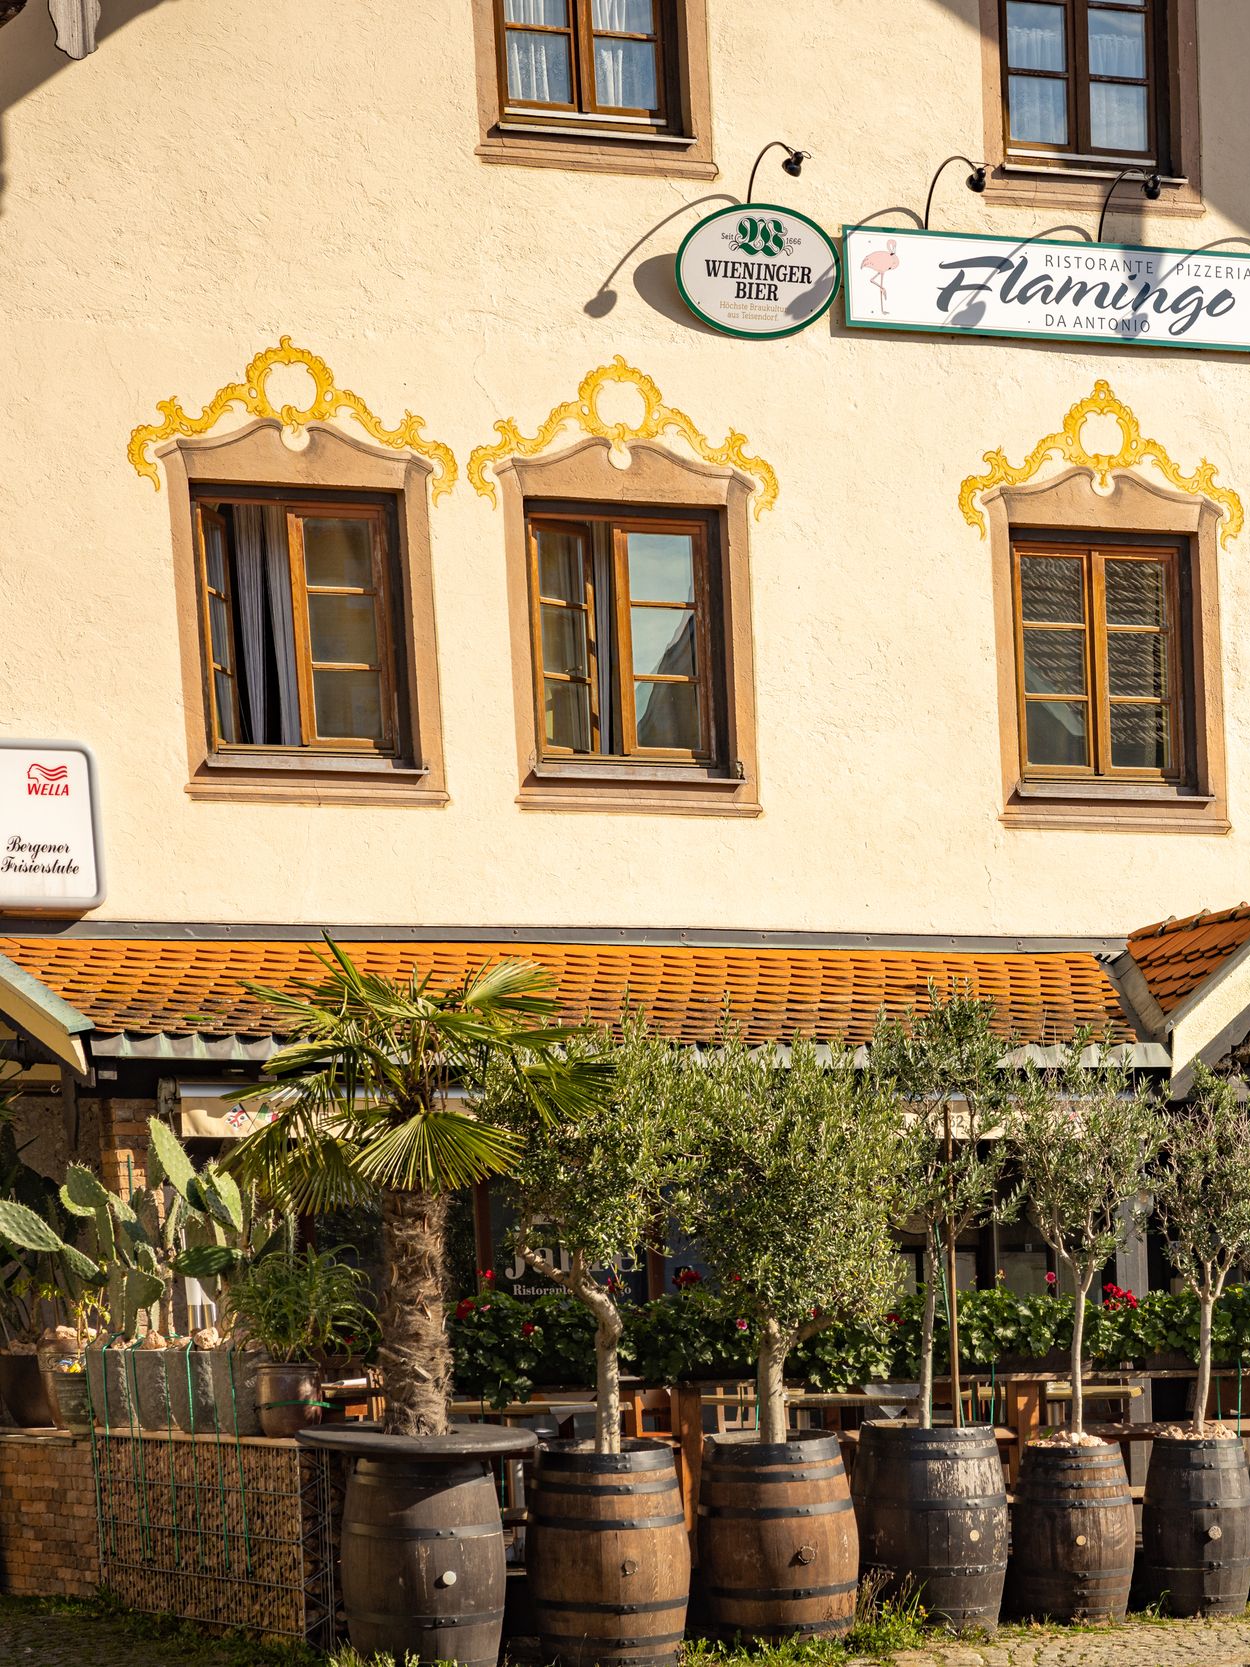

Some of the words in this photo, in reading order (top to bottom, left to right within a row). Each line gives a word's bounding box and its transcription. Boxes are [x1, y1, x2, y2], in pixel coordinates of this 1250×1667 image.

[721, 232, 734, 241] Seit
[786, 237, 802, 246] 1666
[705, 259, 812, 284] WIENINGER
[1045, 254, 1154, 274] RISTORANTE
[735, 281, 779, 301] BIER
[936, 255, 1236, 336] Flamingo
[720, 301, 748, 311] Höchste
[1045, 314, 1067, 328] DA
[1073, 315, 1150, 333] ANTONIO
[27, 783, 69, 796] WELLA
[6, 835, 70, 859] Bergener
[0, 856, 80, 875] Frisierstube
